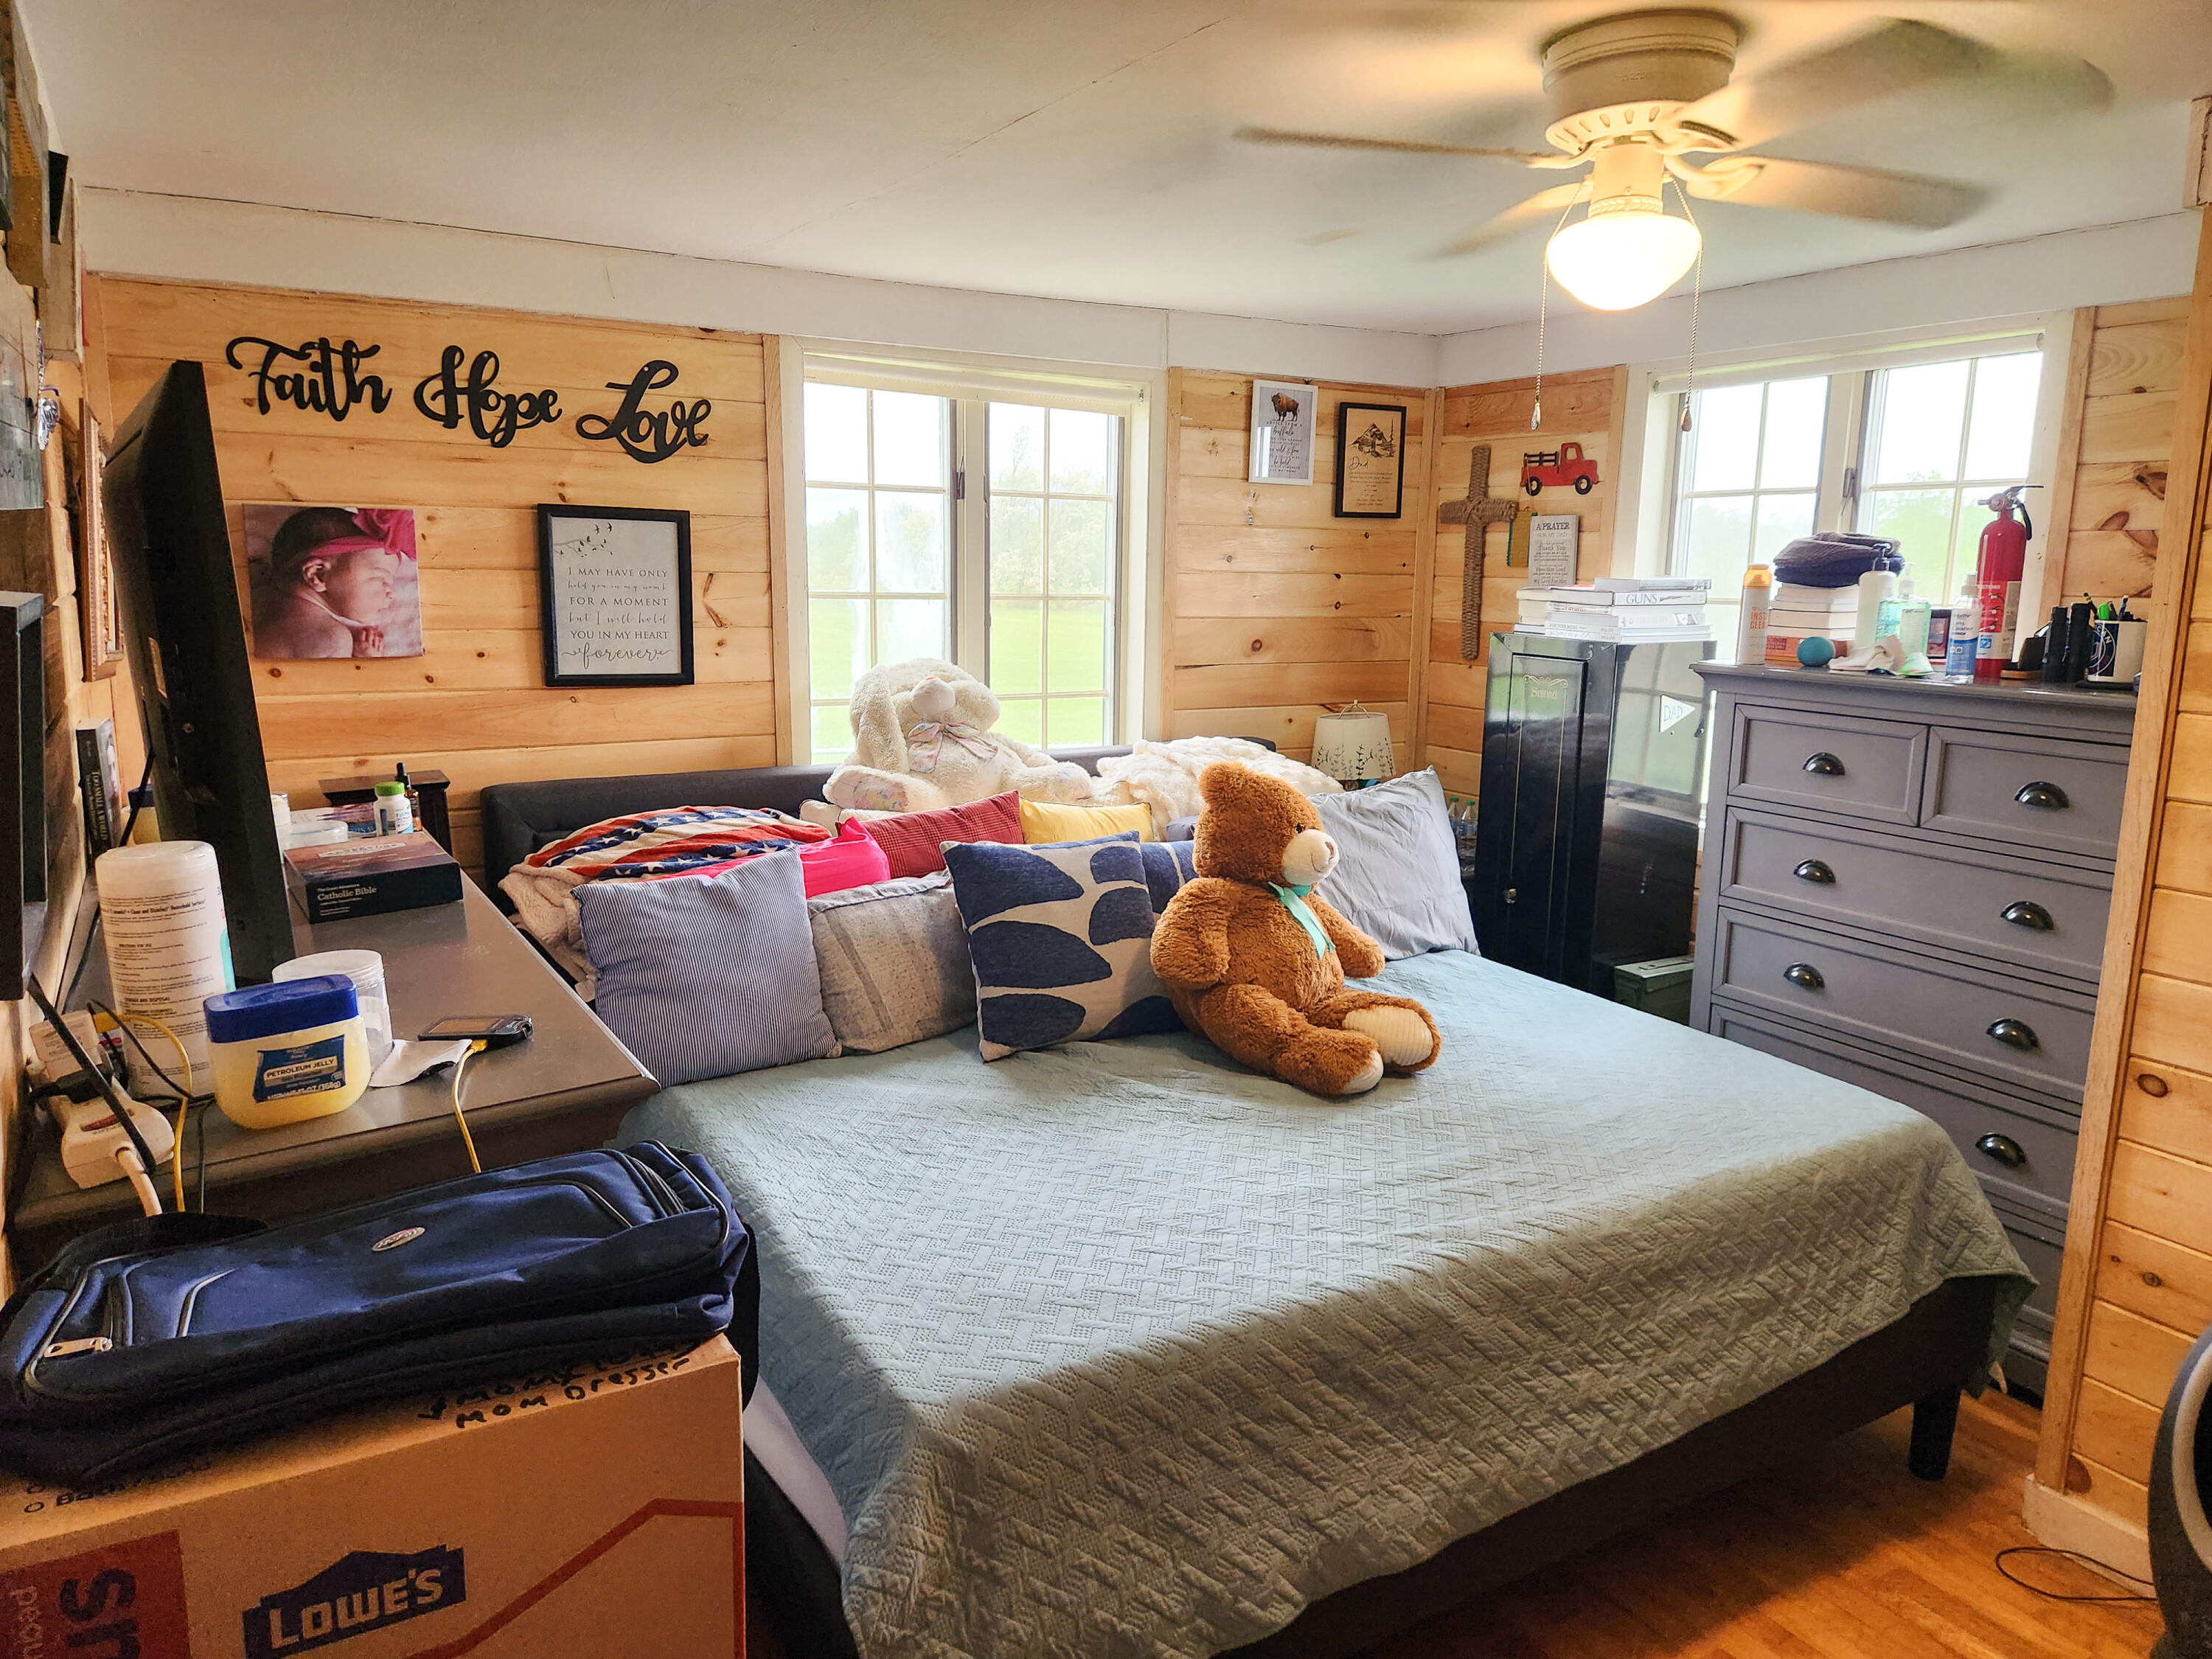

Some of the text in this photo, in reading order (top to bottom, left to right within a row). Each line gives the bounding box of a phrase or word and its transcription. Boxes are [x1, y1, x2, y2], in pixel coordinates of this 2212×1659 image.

[226, 336, 712, 463] Faith Hope Love
[1349, 456, 1368, 470] Dad
[1543, 522, 1569, 530] PRAYER
[568, 567, 668, 577] I MAY HAVE ONLY
[570, 597, 668, 606] FOR A MOMENT
[1627, 593, 1658, 604] GUNS
[569, 611, 667, 625] but I will hold
[570, 630, 669, 639] YOU IN MY HEART
[1663, 705, 1683, 722] DAD
[318, 886, 377, 901] Catholic Bible
[266, 1059, 335, 1078] PETROLEUM JELLY
[268, 1568, 443, 1649] LOWE'S
